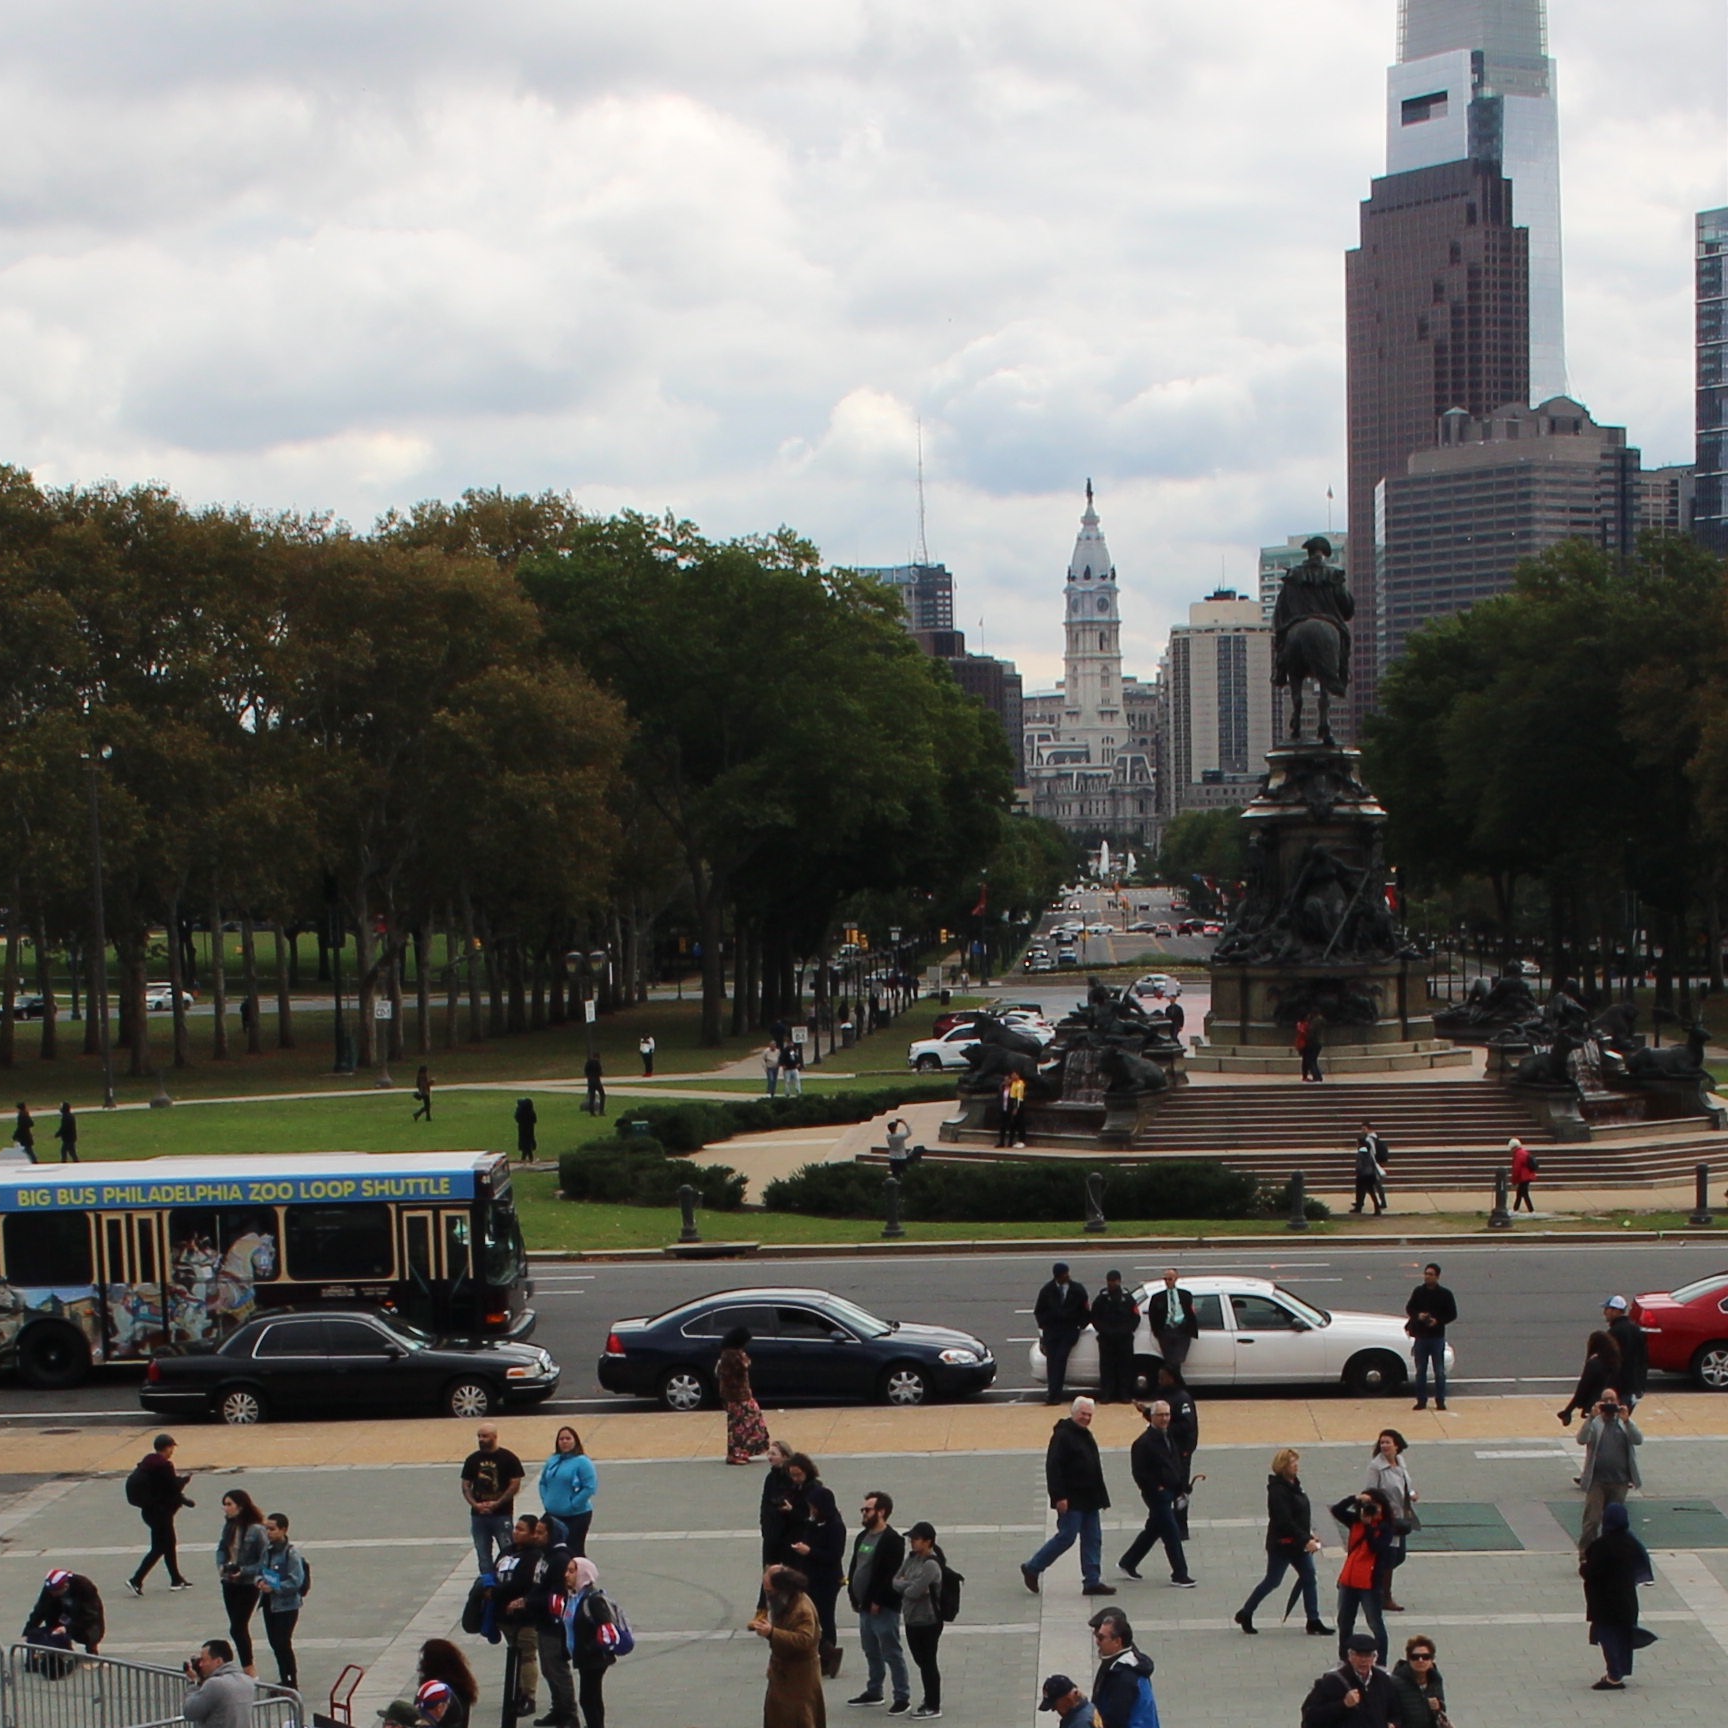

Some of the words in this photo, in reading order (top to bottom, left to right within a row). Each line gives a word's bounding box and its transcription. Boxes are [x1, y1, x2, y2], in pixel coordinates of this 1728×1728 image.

[17, 1188, 52, 1206] BIG
[57, 1187, 97, 1205] BUS
[102, 1183, 243, 1204] PHILADELPHIA
[248, 1182, 294, 1202] ZOO
[299, 1180, 356, 1199] LOOP
[361, 1177, 450, 1196] SHUTTLE
